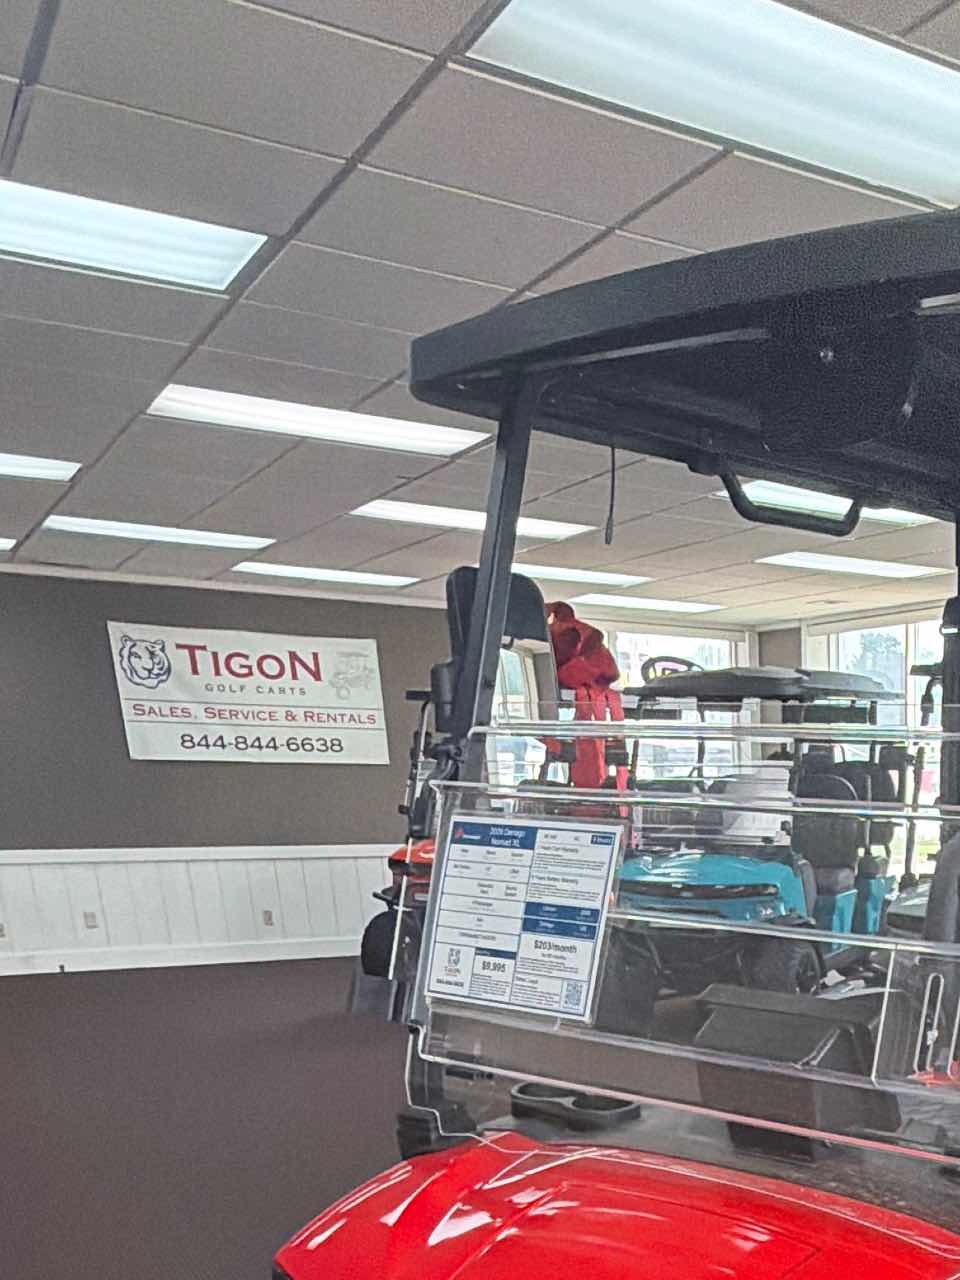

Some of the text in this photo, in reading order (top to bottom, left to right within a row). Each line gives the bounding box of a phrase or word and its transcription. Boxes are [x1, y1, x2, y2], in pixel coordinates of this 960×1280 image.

[175, 643, 323, 682] TIGON
[204, 683, 306, 696] GOLF CARTS
[204, 706, 277, 721] SERVICE
[284, 710, 298, 722] &
[304, 711, 377, 725] RENTALS
[180, 733, 344, 753] 844-844-6638
